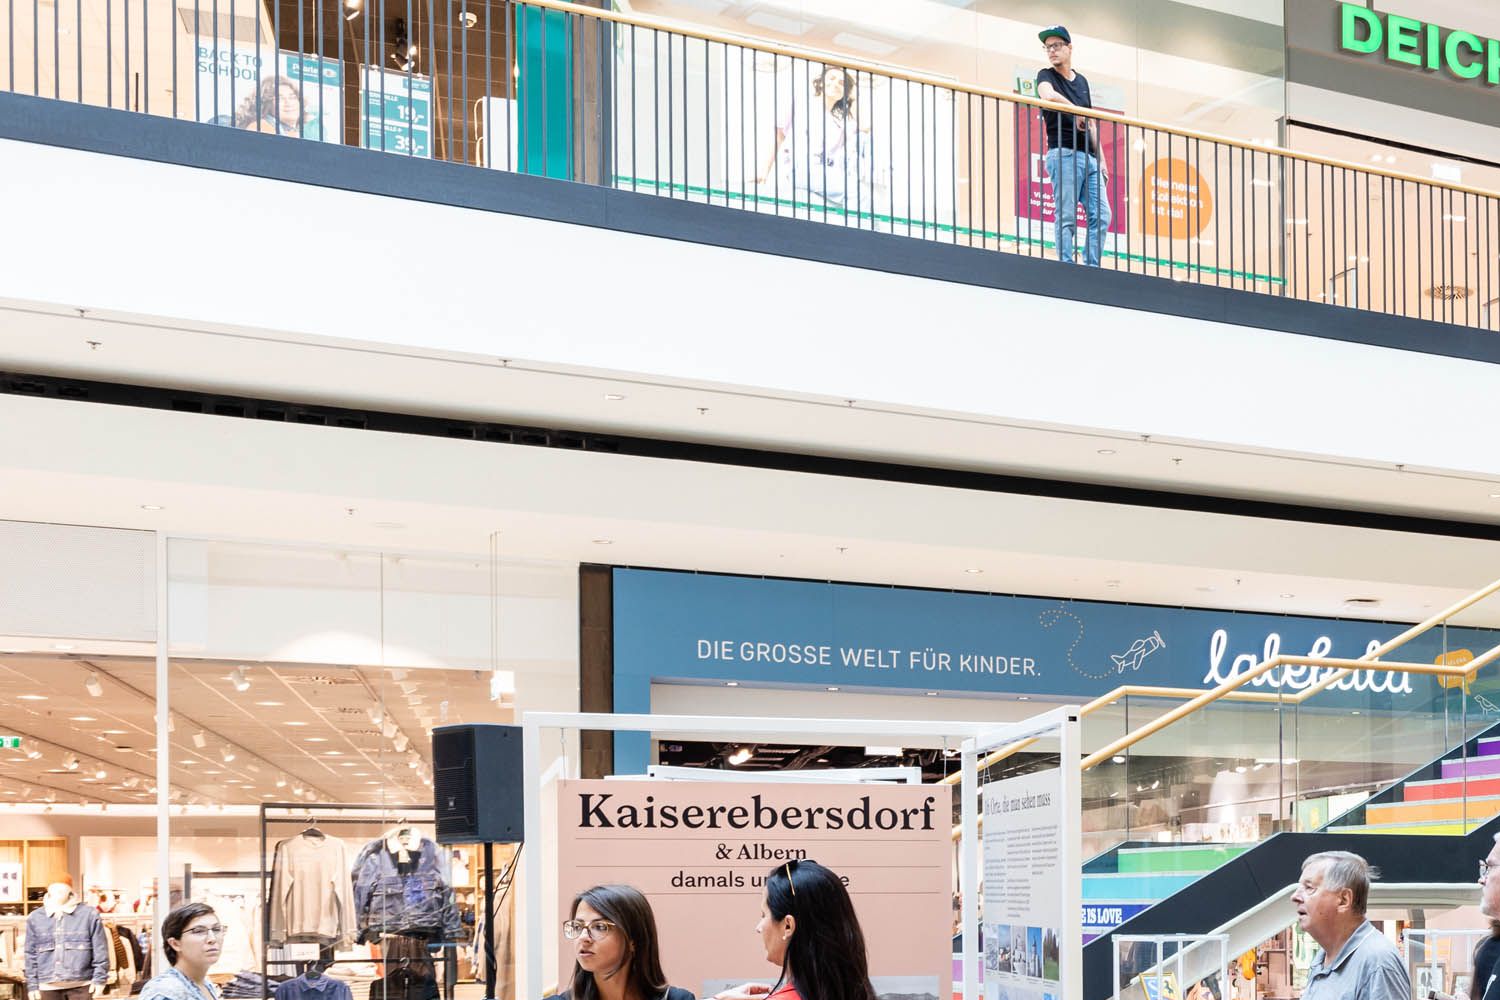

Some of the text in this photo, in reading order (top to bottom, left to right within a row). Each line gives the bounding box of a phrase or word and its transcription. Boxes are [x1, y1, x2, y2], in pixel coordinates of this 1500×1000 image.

[199, 47, 241, 66] BACK
[1151, 190, 1204, 209] Kollekton
[698, 639, 1042, 677] DIE GROSSE WELT FÜR KINDER.
[577, 793, 936, 831] Kaiserebersdorf
[715, 843, 808, 861] & Albern
[671, 870, 745, 888] damals
[1087, 907, 1097, 923] IS
[1098, 907, 1123, 924] LOVE
